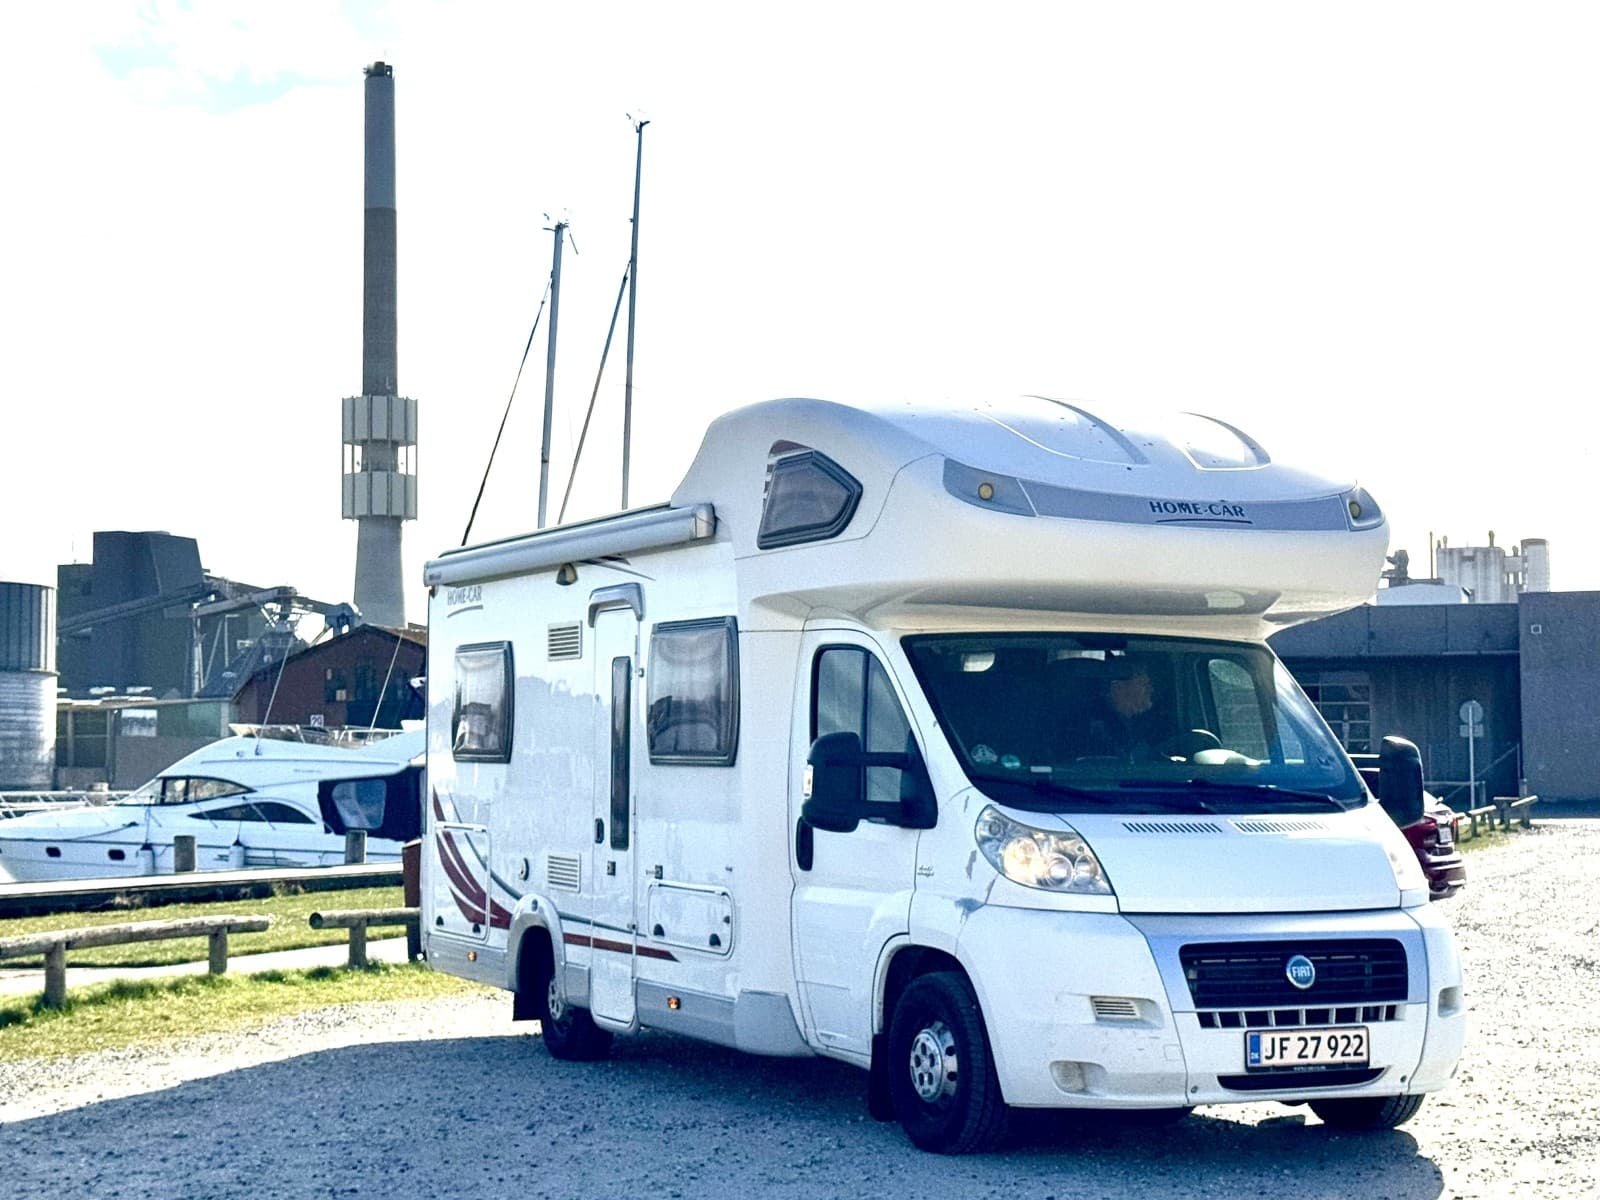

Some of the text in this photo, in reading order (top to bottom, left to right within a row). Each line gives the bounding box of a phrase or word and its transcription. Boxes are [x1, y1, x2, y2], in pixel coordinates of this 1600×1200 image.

[1149, 501, 1245, 517] HOME-CAR
[1292, 966, 1310, 978] FIAT
[1264, 1034, 1363, 1060] JF 27 922
